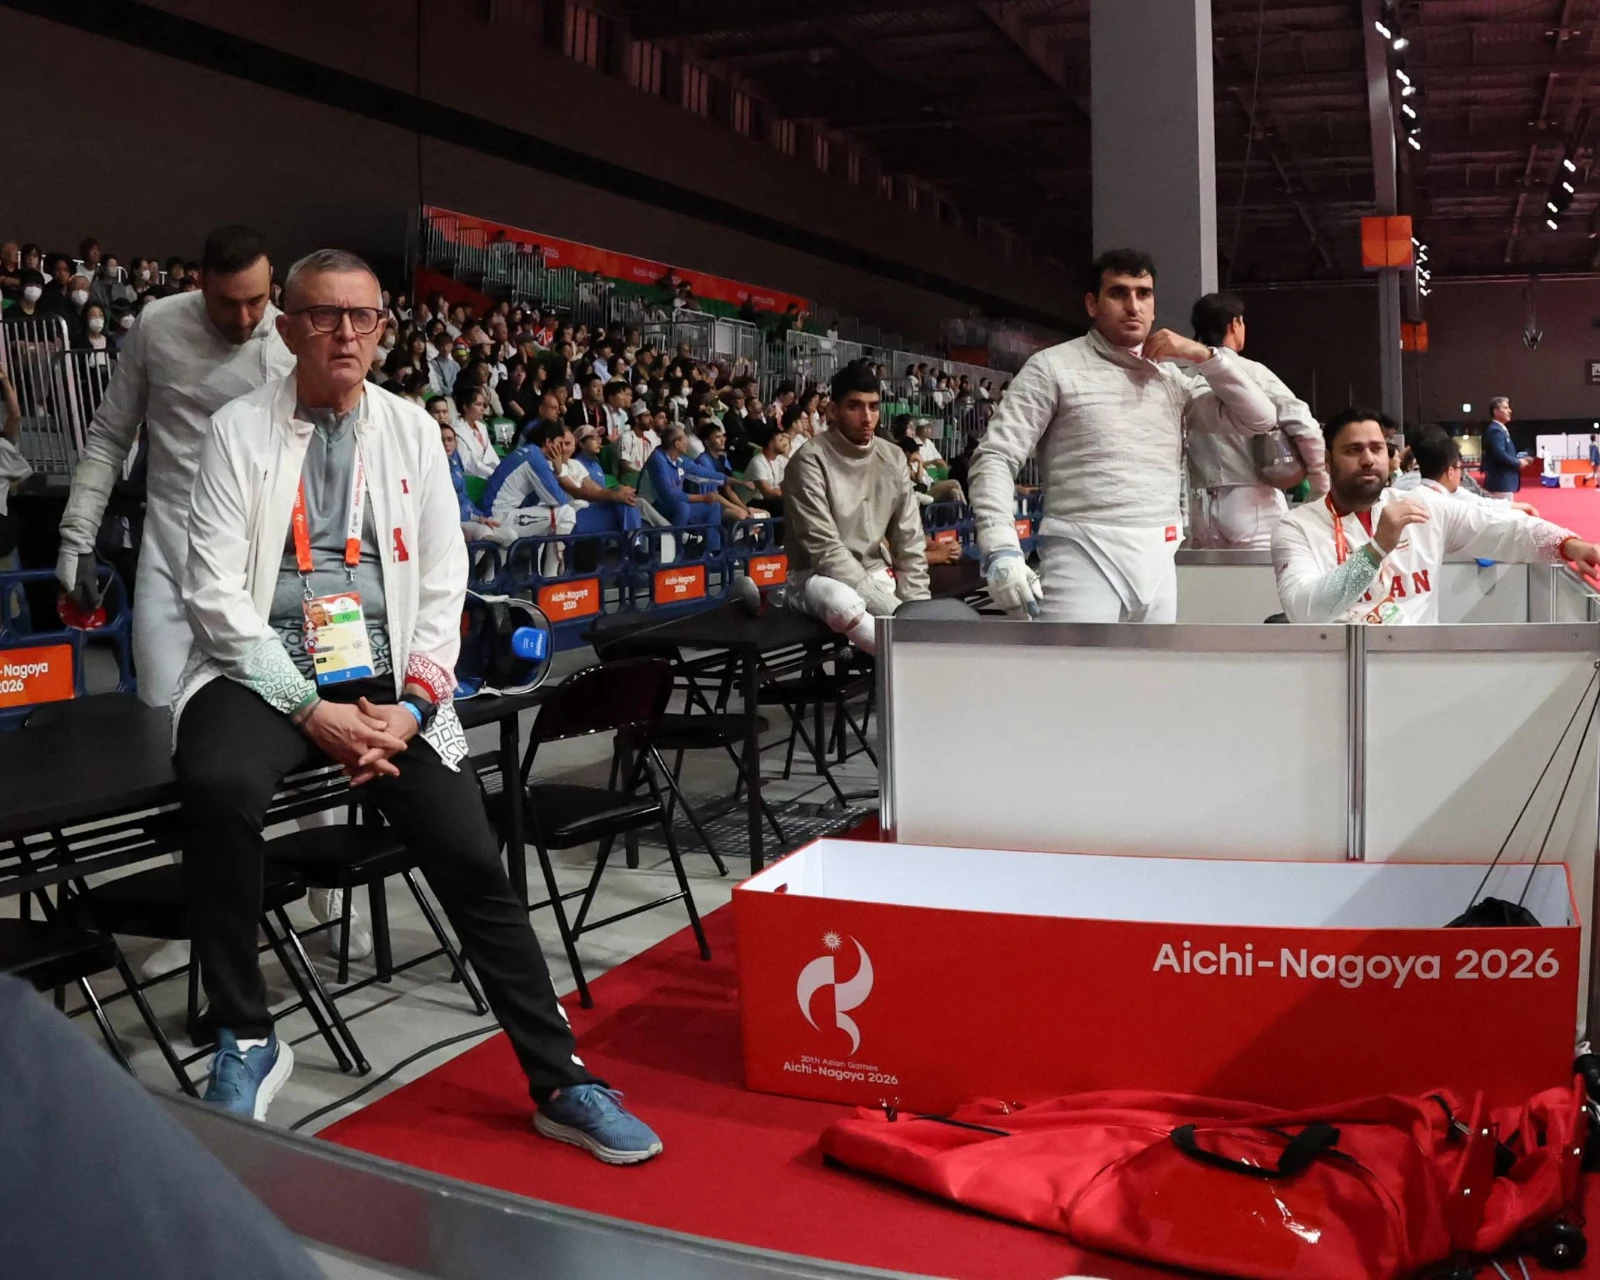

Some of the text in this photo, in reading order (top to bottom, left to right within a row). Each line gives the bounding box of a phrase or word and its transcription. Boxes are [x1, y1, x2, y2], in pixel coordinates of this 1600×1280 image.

[551, 589, 589, 603] Aichi-Nagoya
[563, 600, 577, 611] 2026
[1152, 940, 1560, 989] Aichi-Nagoya 2026
[801, 1054, 879, 1072] 20th Asian Games
[783, 1061, 899, 1085] Aichi-Nagoya 2026
